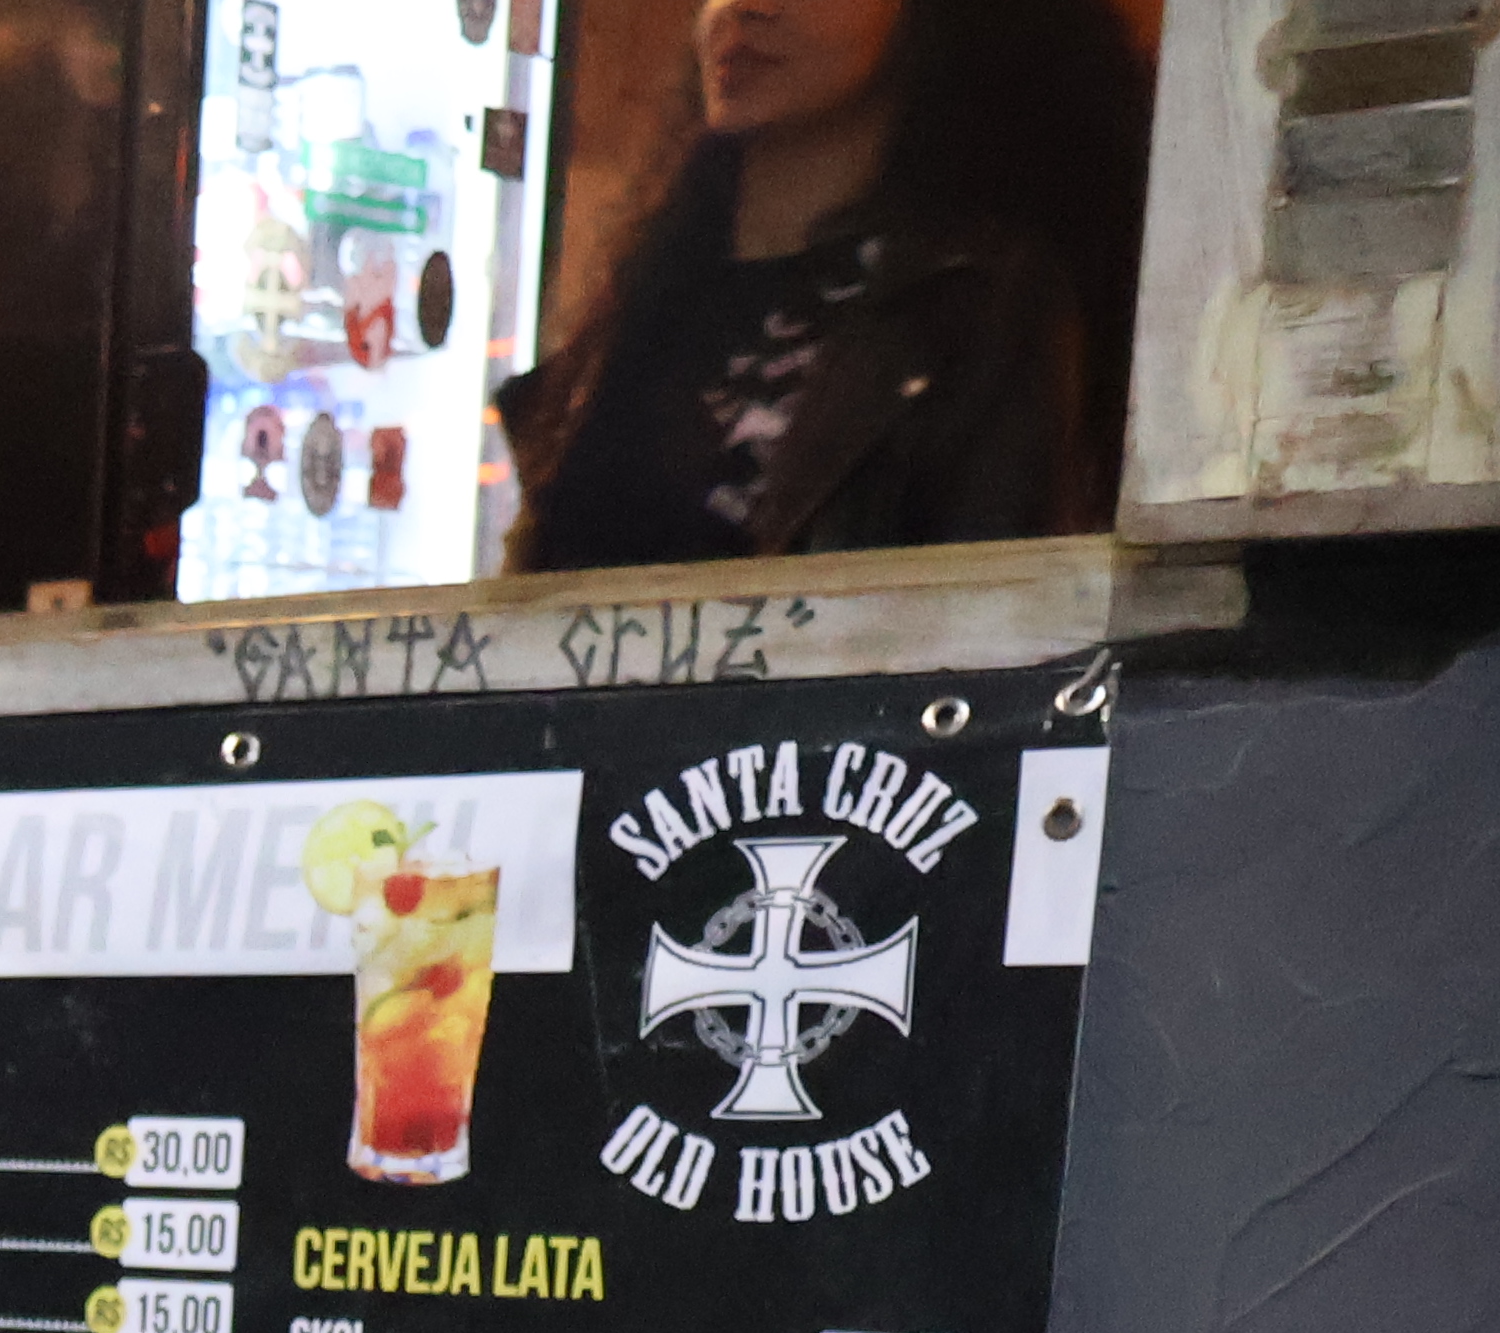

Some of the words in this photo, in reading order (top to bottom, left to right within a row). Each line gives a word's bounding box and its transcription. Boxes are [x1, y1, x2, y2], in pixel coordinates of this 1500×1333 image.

[609, 740, 803, 881] SANTA
[823, 741, 980, 875] CRUZ
[142, 1130, 233, 1176] 30,00
[599, 1104, 717, 1211] OLD
[734, 1109, 932, 1223] HOUSE
[143, 1212, 227, 1257] 15,00
[294, 1226, 481, 1297] CERVEJA
[493, 1235, 605, 1302] LATA
